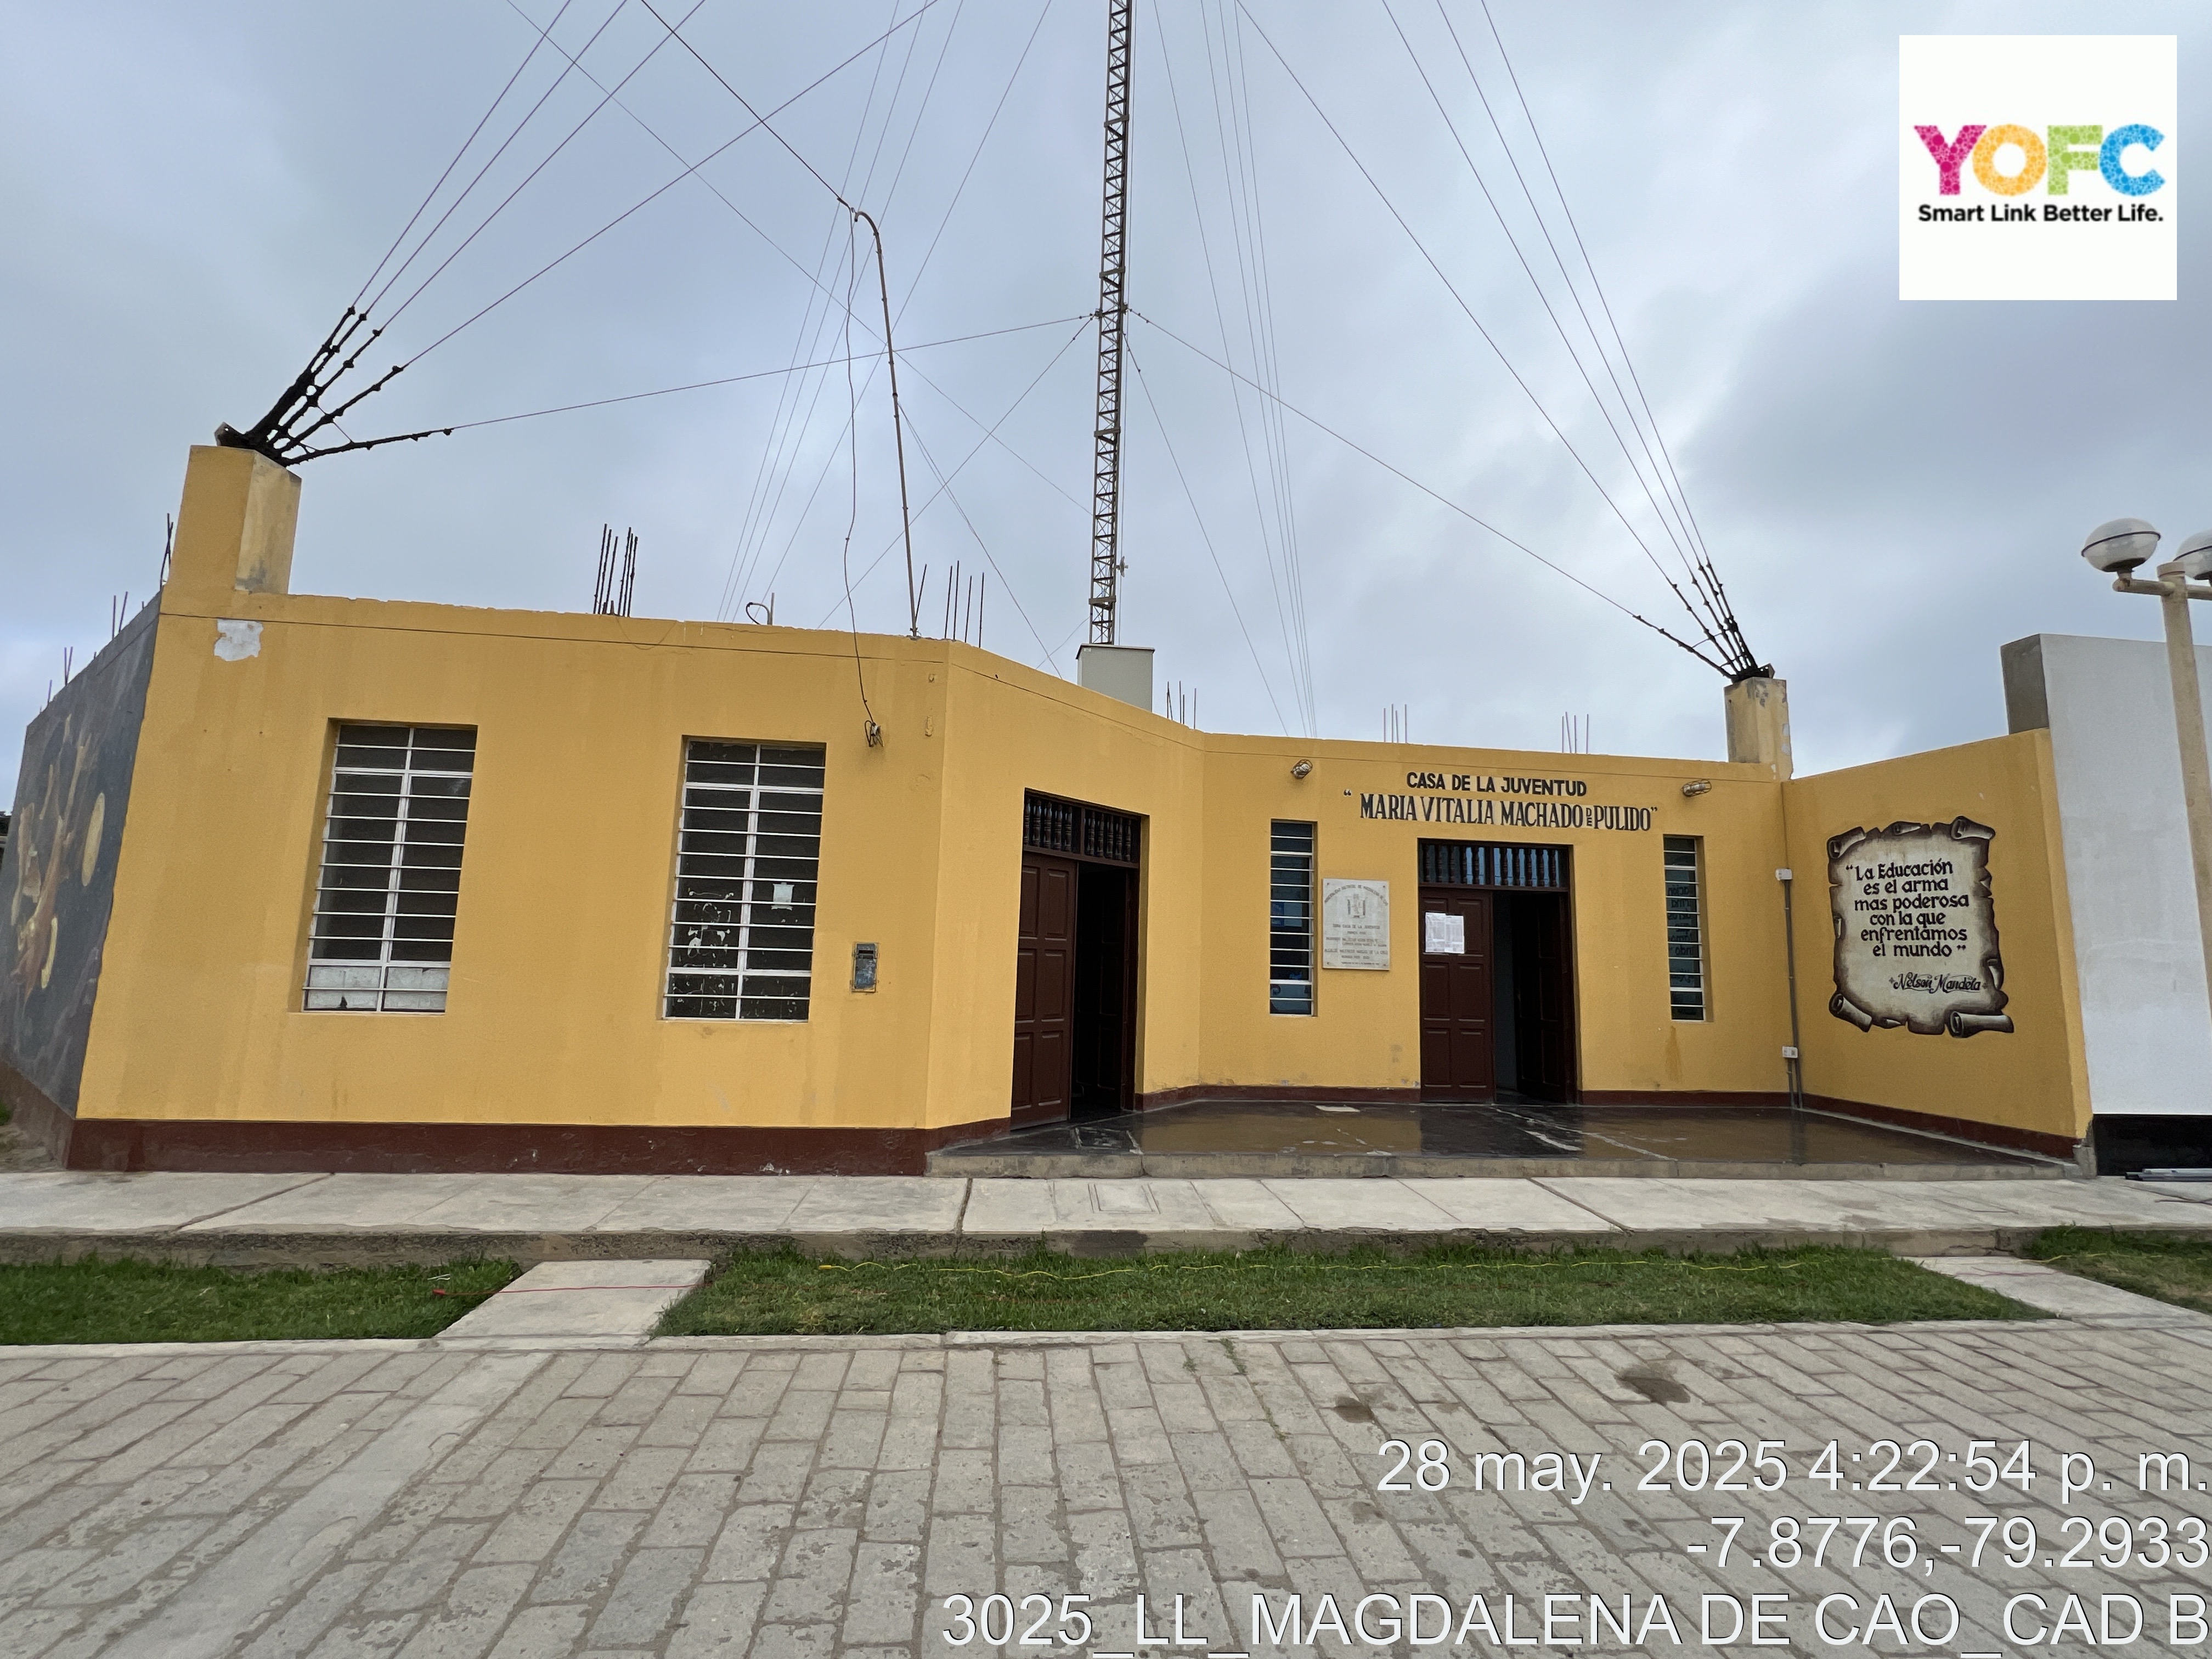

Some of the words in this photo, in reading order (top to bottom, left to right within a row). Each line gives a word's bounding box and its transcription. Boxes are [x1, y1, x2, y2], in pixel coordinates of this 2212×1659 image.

[1407, 772, 1446, 789] CASA
[1452, 774, 1470, 791] DE
[1477, 776, 1495, 792] LA
[1500, 777, 1587, 796] JUVENTUD
[1420, 796, 1493, 825] VITALIA
[1500, 801, 1584, 828] MACHADO
[1877, 857, 1953, 879] Educación
[1863, 882, 1880, 895] es
[1884, 879, 1898, 894] el
[1901, 878, 1949, 893] arma
[1854, 898, 1888, 911] mas
[1892, 893, 1970, 913] poderosa
[1870, 913, 1895, 926] con
[1899, 911, 1913, 925] la
[1916, 912, 1946, 928] que
[1860, 926, 1968, 944] enfrentamos
[1872, 943, 1886, 956] el
[1893, 972, 1933, 991] Nelson
[1929, 973, 1981, 994] Mandela
